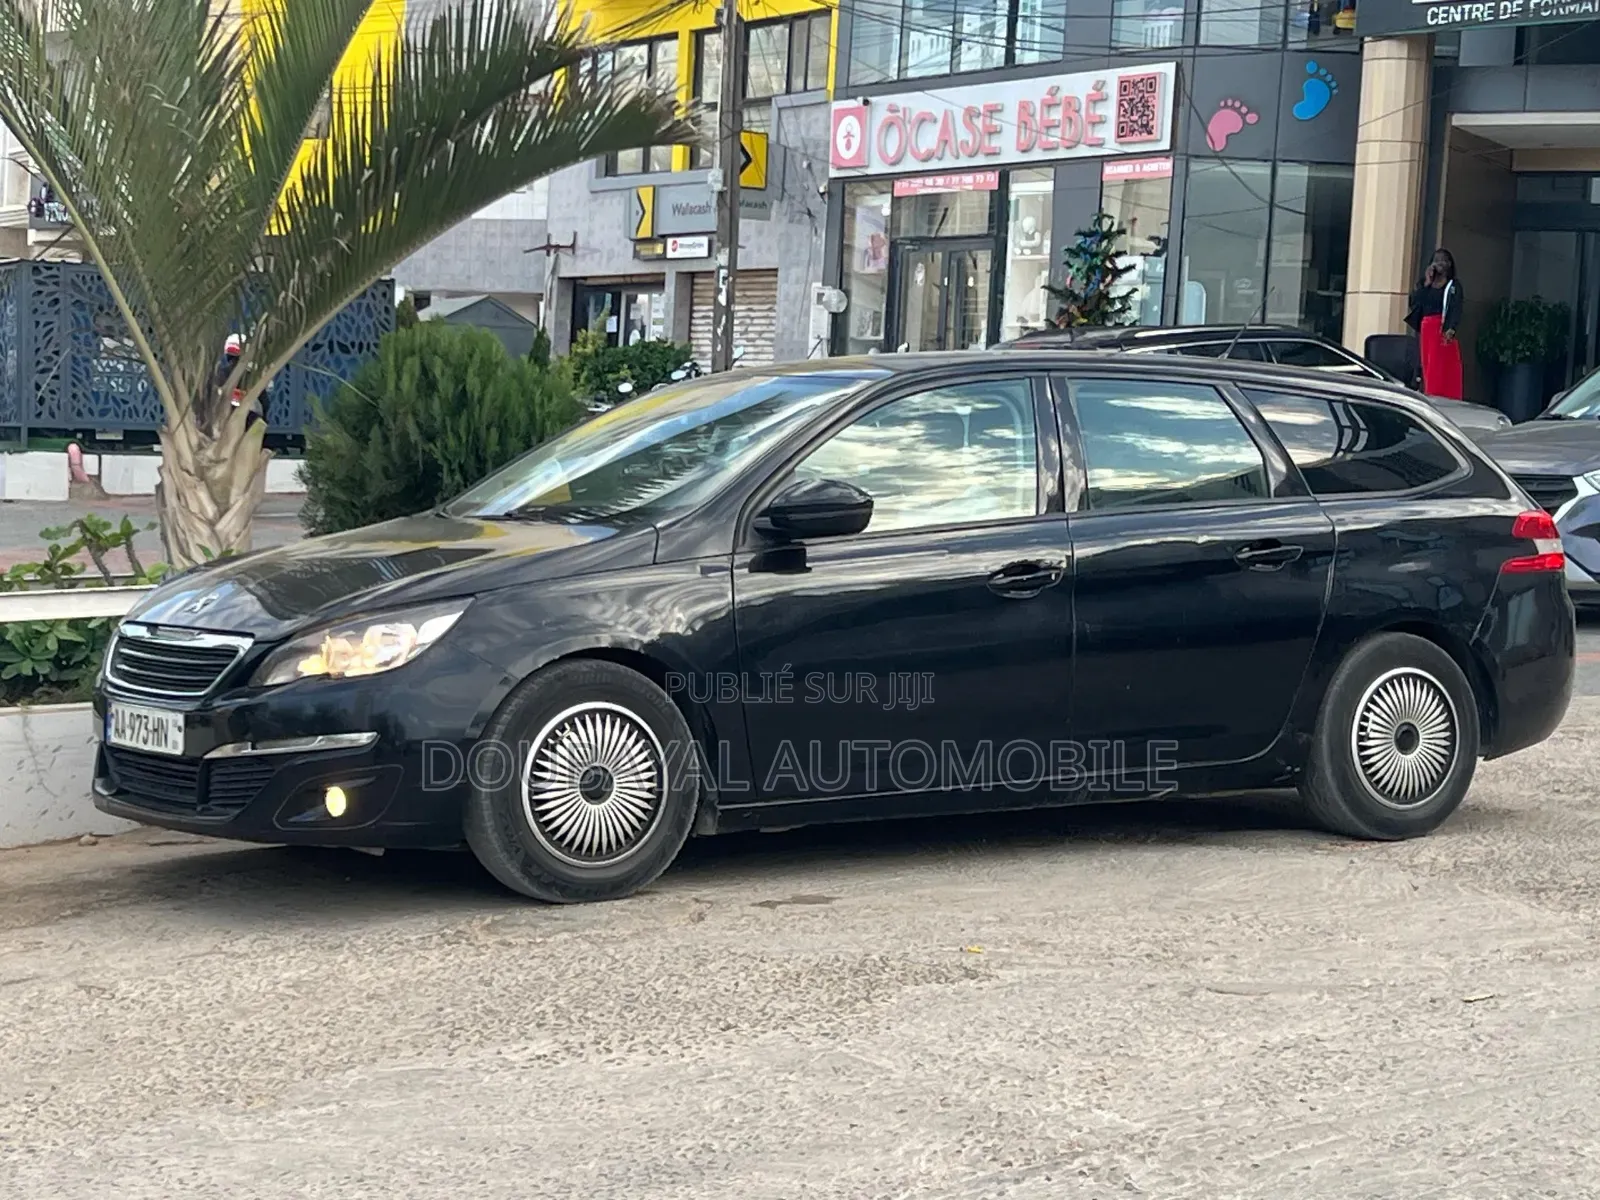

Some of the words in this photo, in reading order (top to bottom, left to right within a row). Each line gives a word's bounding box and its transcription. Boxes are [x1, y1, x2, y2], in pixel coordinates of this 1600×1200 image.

[1427, 2, 1495, 25] CENTRE
[1499, 0, 1523, 20] DE
[1016, 79, 1109, 153] BÉBÉ
